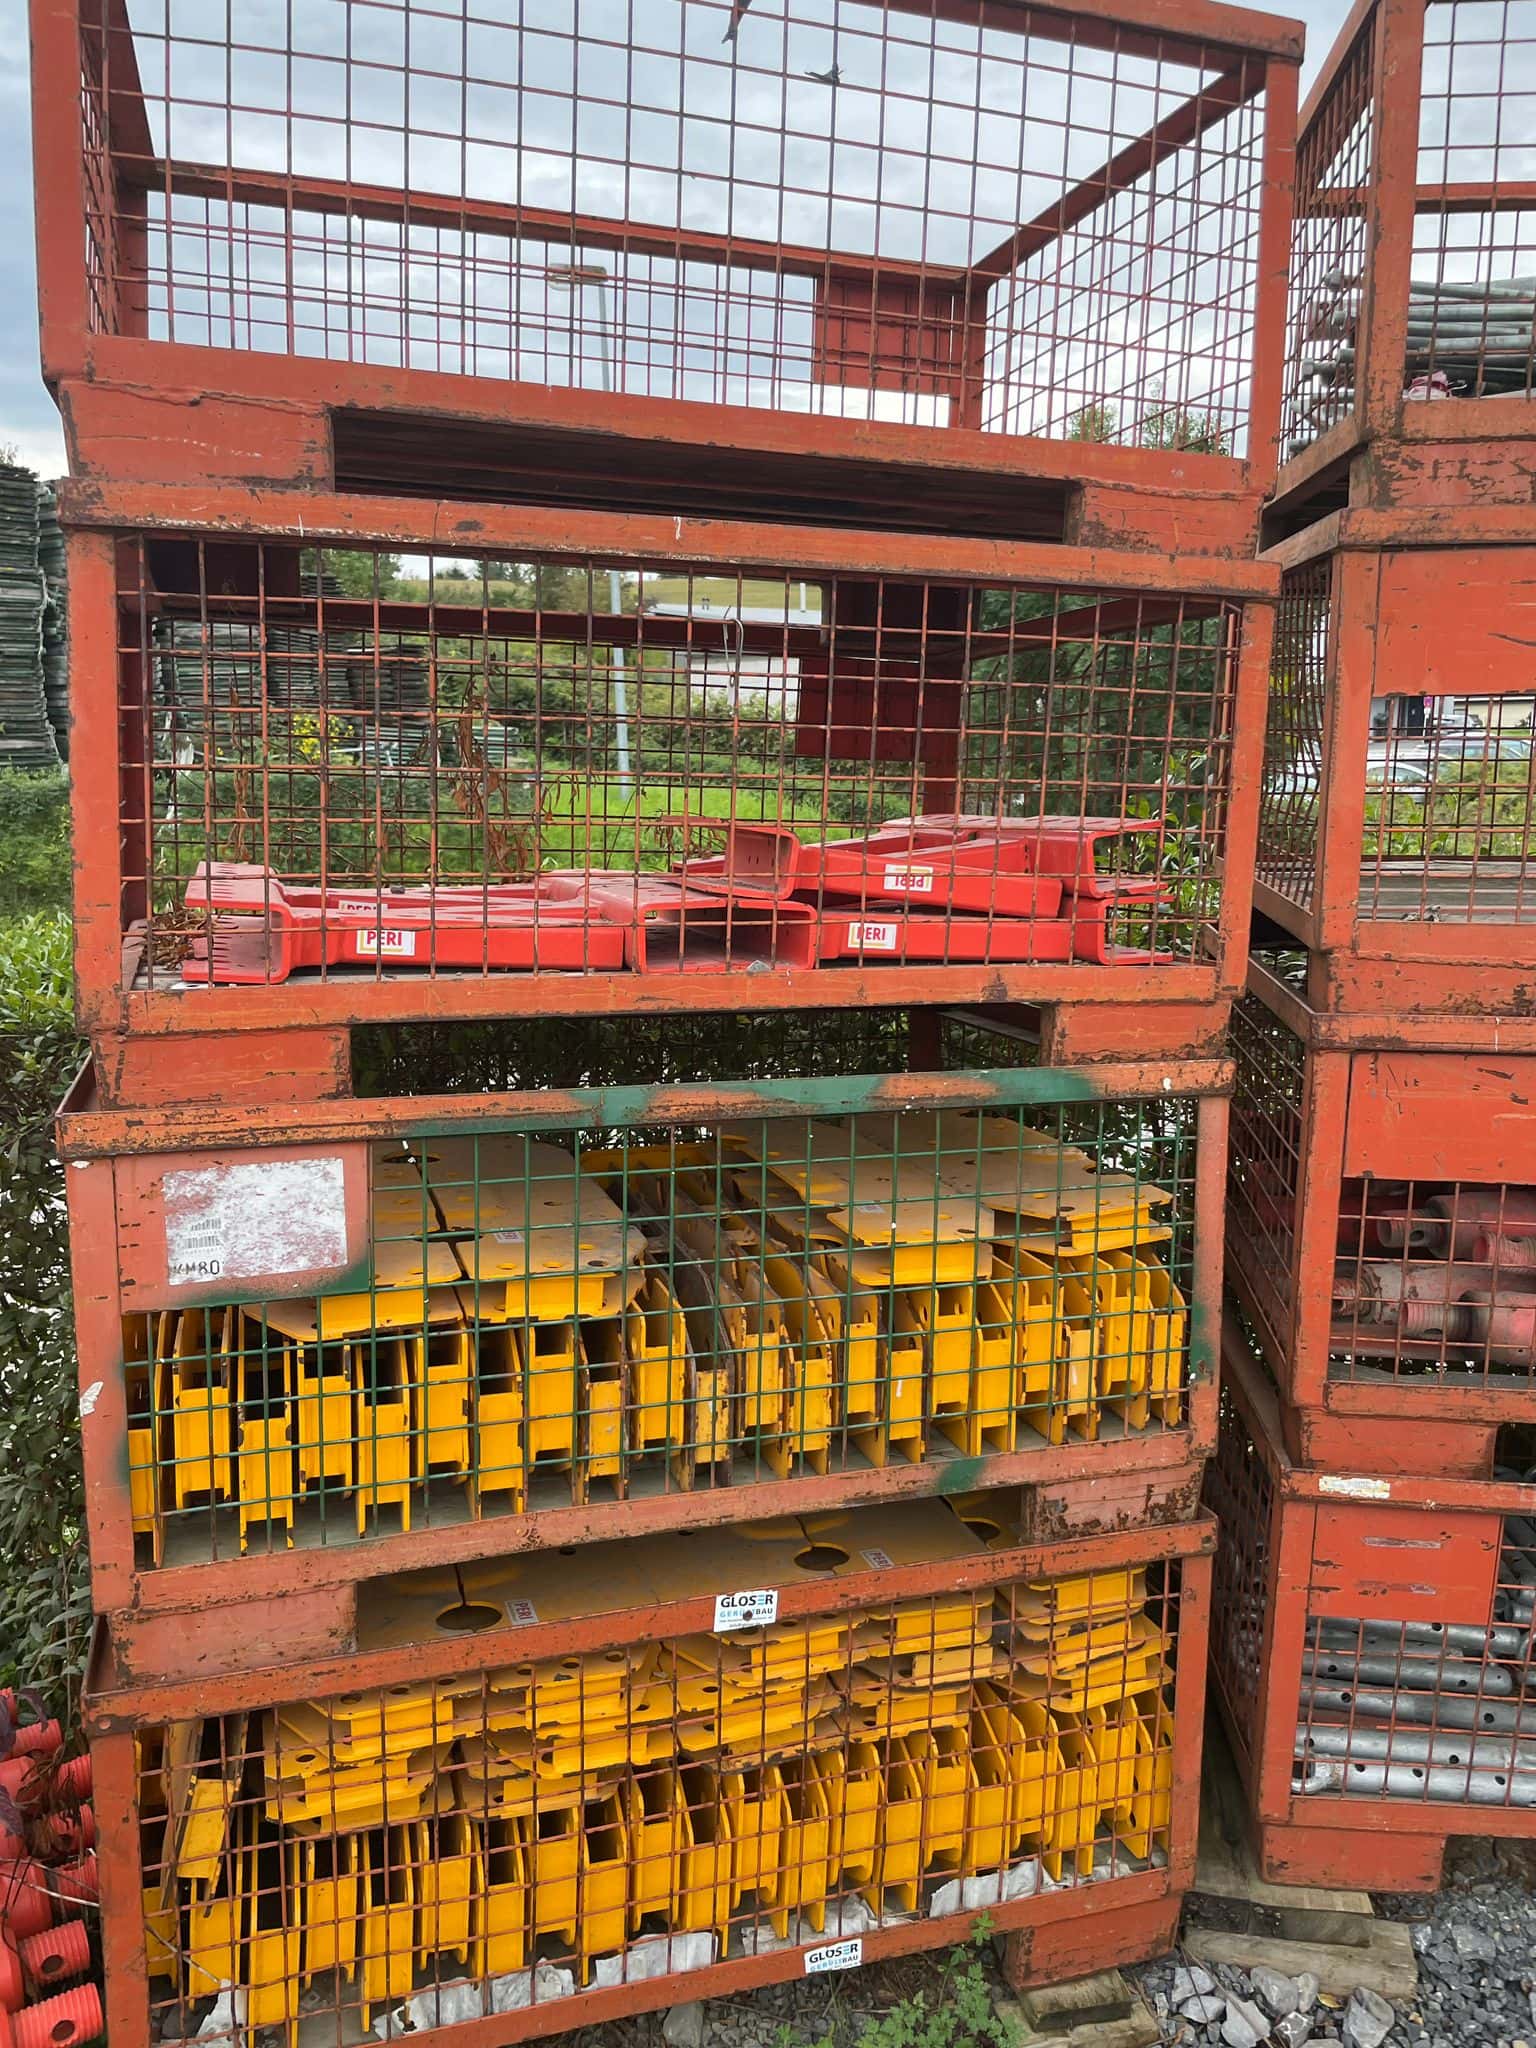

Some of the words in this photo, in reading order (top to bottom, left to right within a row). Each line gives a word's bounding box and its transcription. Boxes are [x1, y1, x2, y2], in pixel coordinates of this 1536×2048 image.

[720, 1594, 774, 1608] GLOSER
[719, 1607, 773, 1618] GERÜTBAU
[809, 1943, 858, 1964] GLOSER
